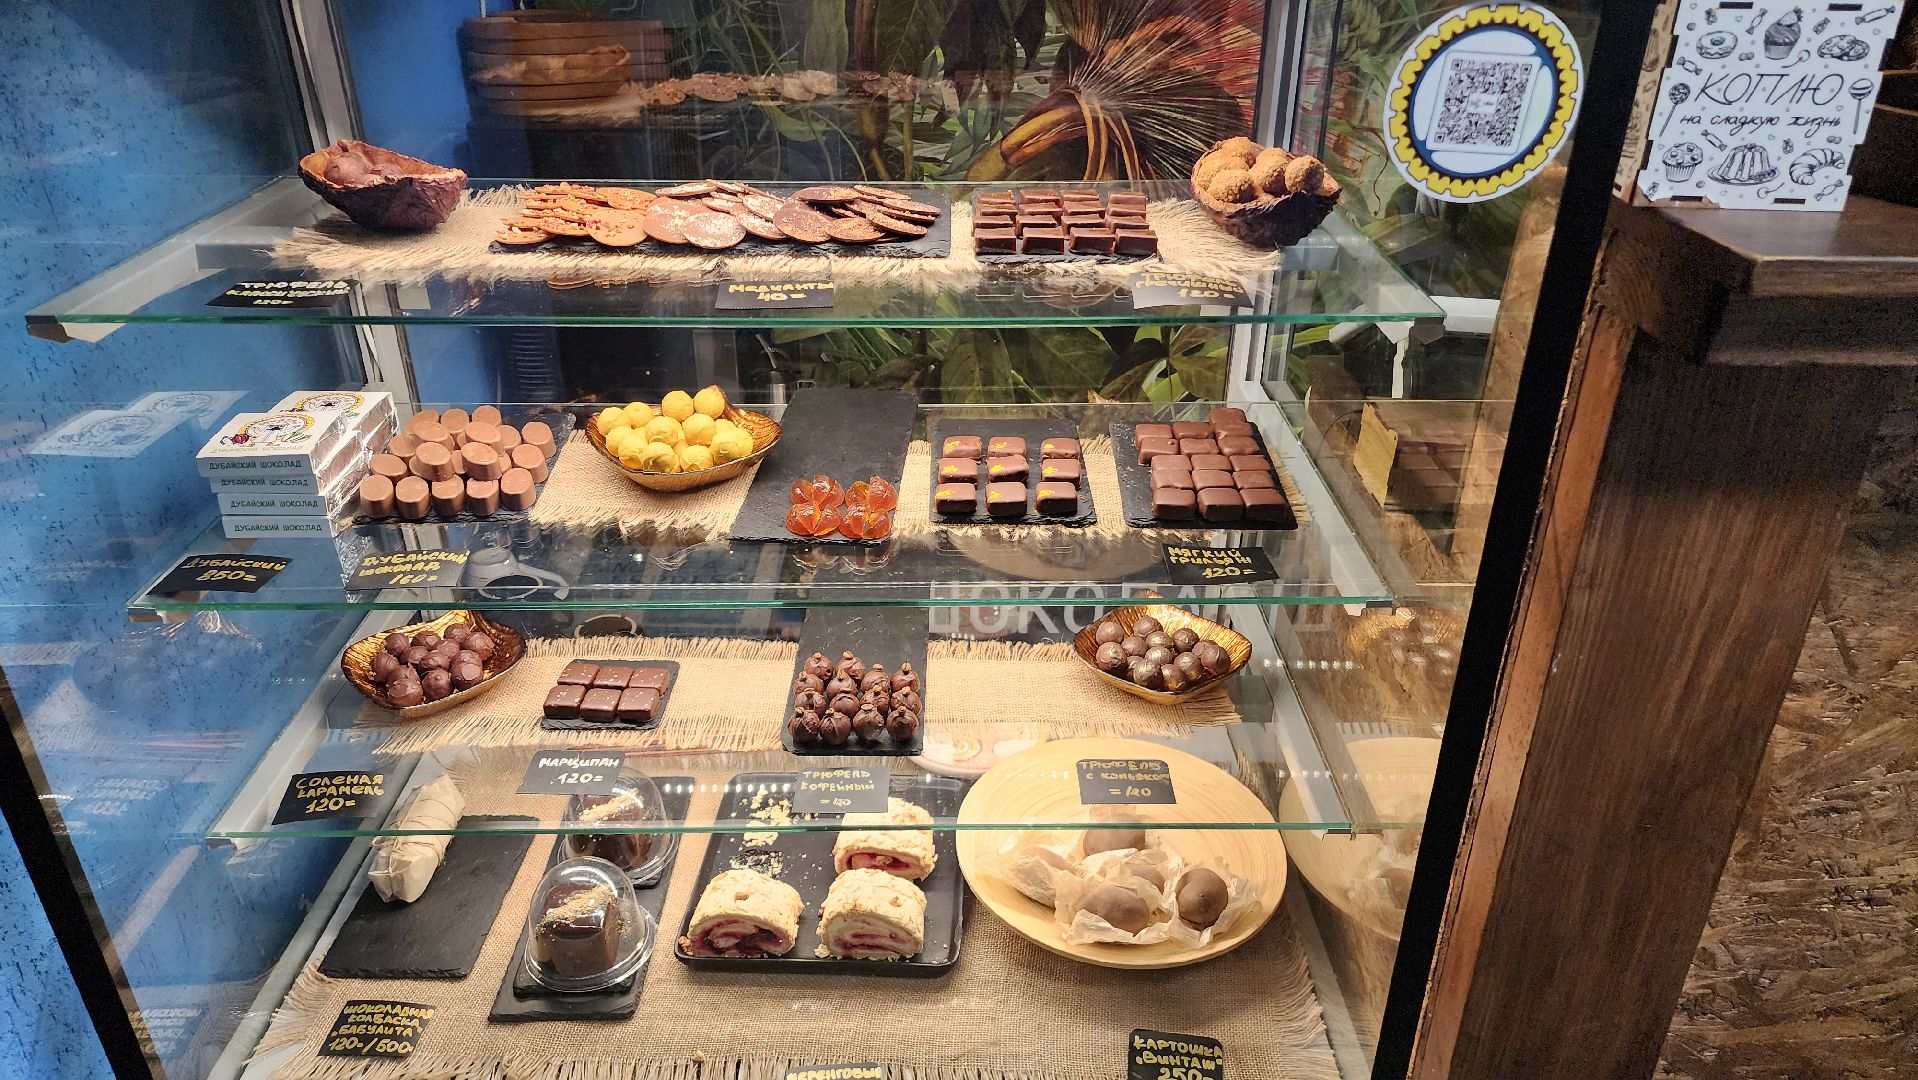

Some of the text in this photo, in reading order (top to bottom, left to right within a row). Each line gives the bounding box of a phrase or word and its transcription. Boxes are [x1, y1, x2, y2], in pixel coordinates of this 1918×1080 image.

[1695, 73, 1844, 106] КОПЛЮ
[1680, 115, 1842, 138] на сладкую жизнь
[209, 460, 302, 469] ДУБАЙСКИЙ ШОКОЛАД
[221, 478, 309, 487] ДУБАЙСКИЙ ШОКОЛАД
[230, 500, 319, 508] ДУБАЙСКИЙ ШОКОЛАД
[234, 524, 322, 532] ДУБАЙСКИЙ ШОКОЛАД
[362, 550, 471, 567] ДУБАЙСКИЙ
[1167, 546, 1242, 558] МЯГКИЙ
[180, 557, 288, 571] ДУБАЙСКИЙ
[358, 561, 441, 576] ШОКОЛАД
[538, 758, 620, 769] МАРЦИПАН
[802, 769, 871, 779] ТРЮФЕЛЬ
[296, 775, 384, 789] СОЛЕНАЯ
[297, 785, 385, 799] КАРАМЕЛЬ
[343, 1003, 435, 1019] ШОКОЛАДНАЯ
[1133, 1035, 1222, 1058] КАРТОШКА
